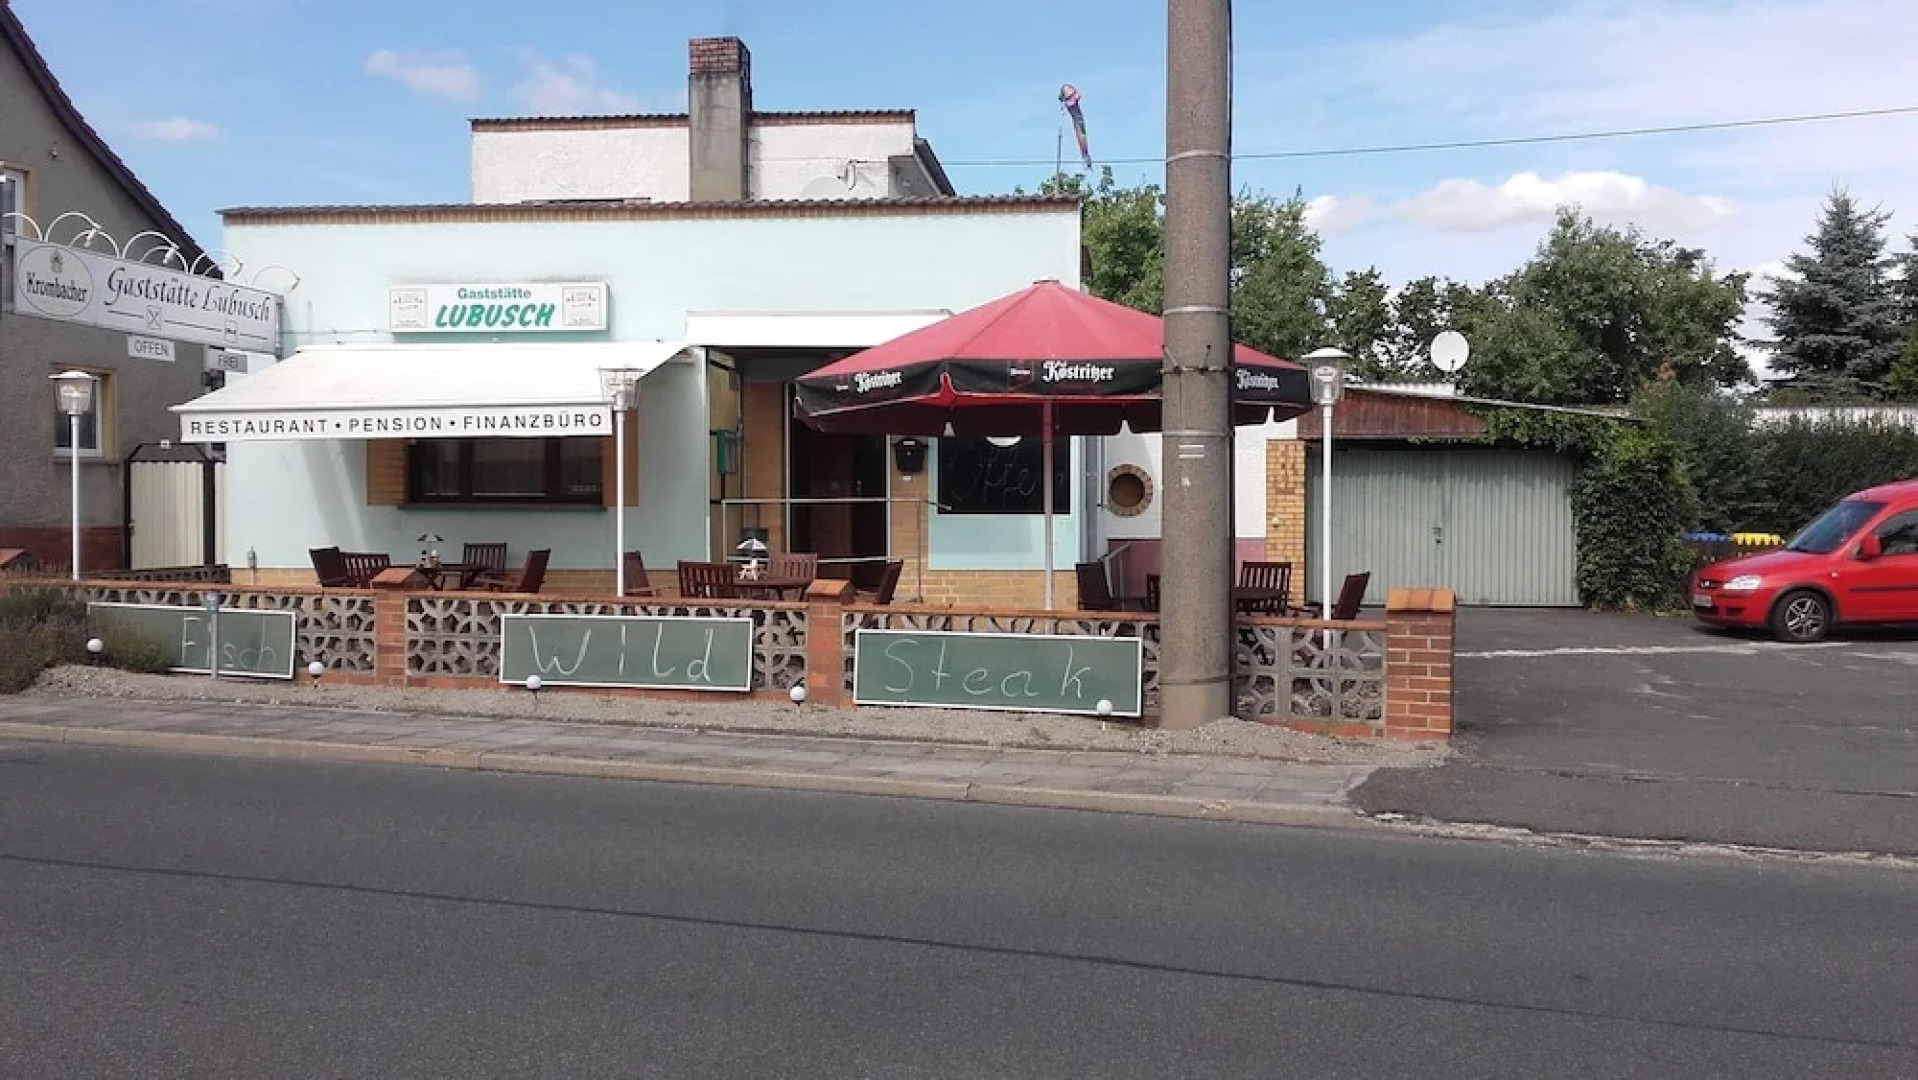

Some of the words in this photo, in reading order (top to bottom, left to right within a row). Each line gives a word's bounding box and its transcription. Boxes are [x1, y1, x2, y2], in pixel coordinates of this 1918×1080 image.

[26, 271, 87, 303] Krombacher
[104, 266, 196, 308] Gaststätte
[201, 285, 269, 321] Lubusch
[457, 287, 532, 300] Gaststätte
[434, 303, 556, 327] LUBUSCH
[133, 338, 170, 356] OFFEN
[1042, 361, 1115, 383] Köstritzer
[190, 418, 328, 435] RESTAURANT
[348, 416, 443, 432] PENSION
[463, 410, 602, 430] FINANZBÜRO
[883, 638, 1091, 699] Steak
